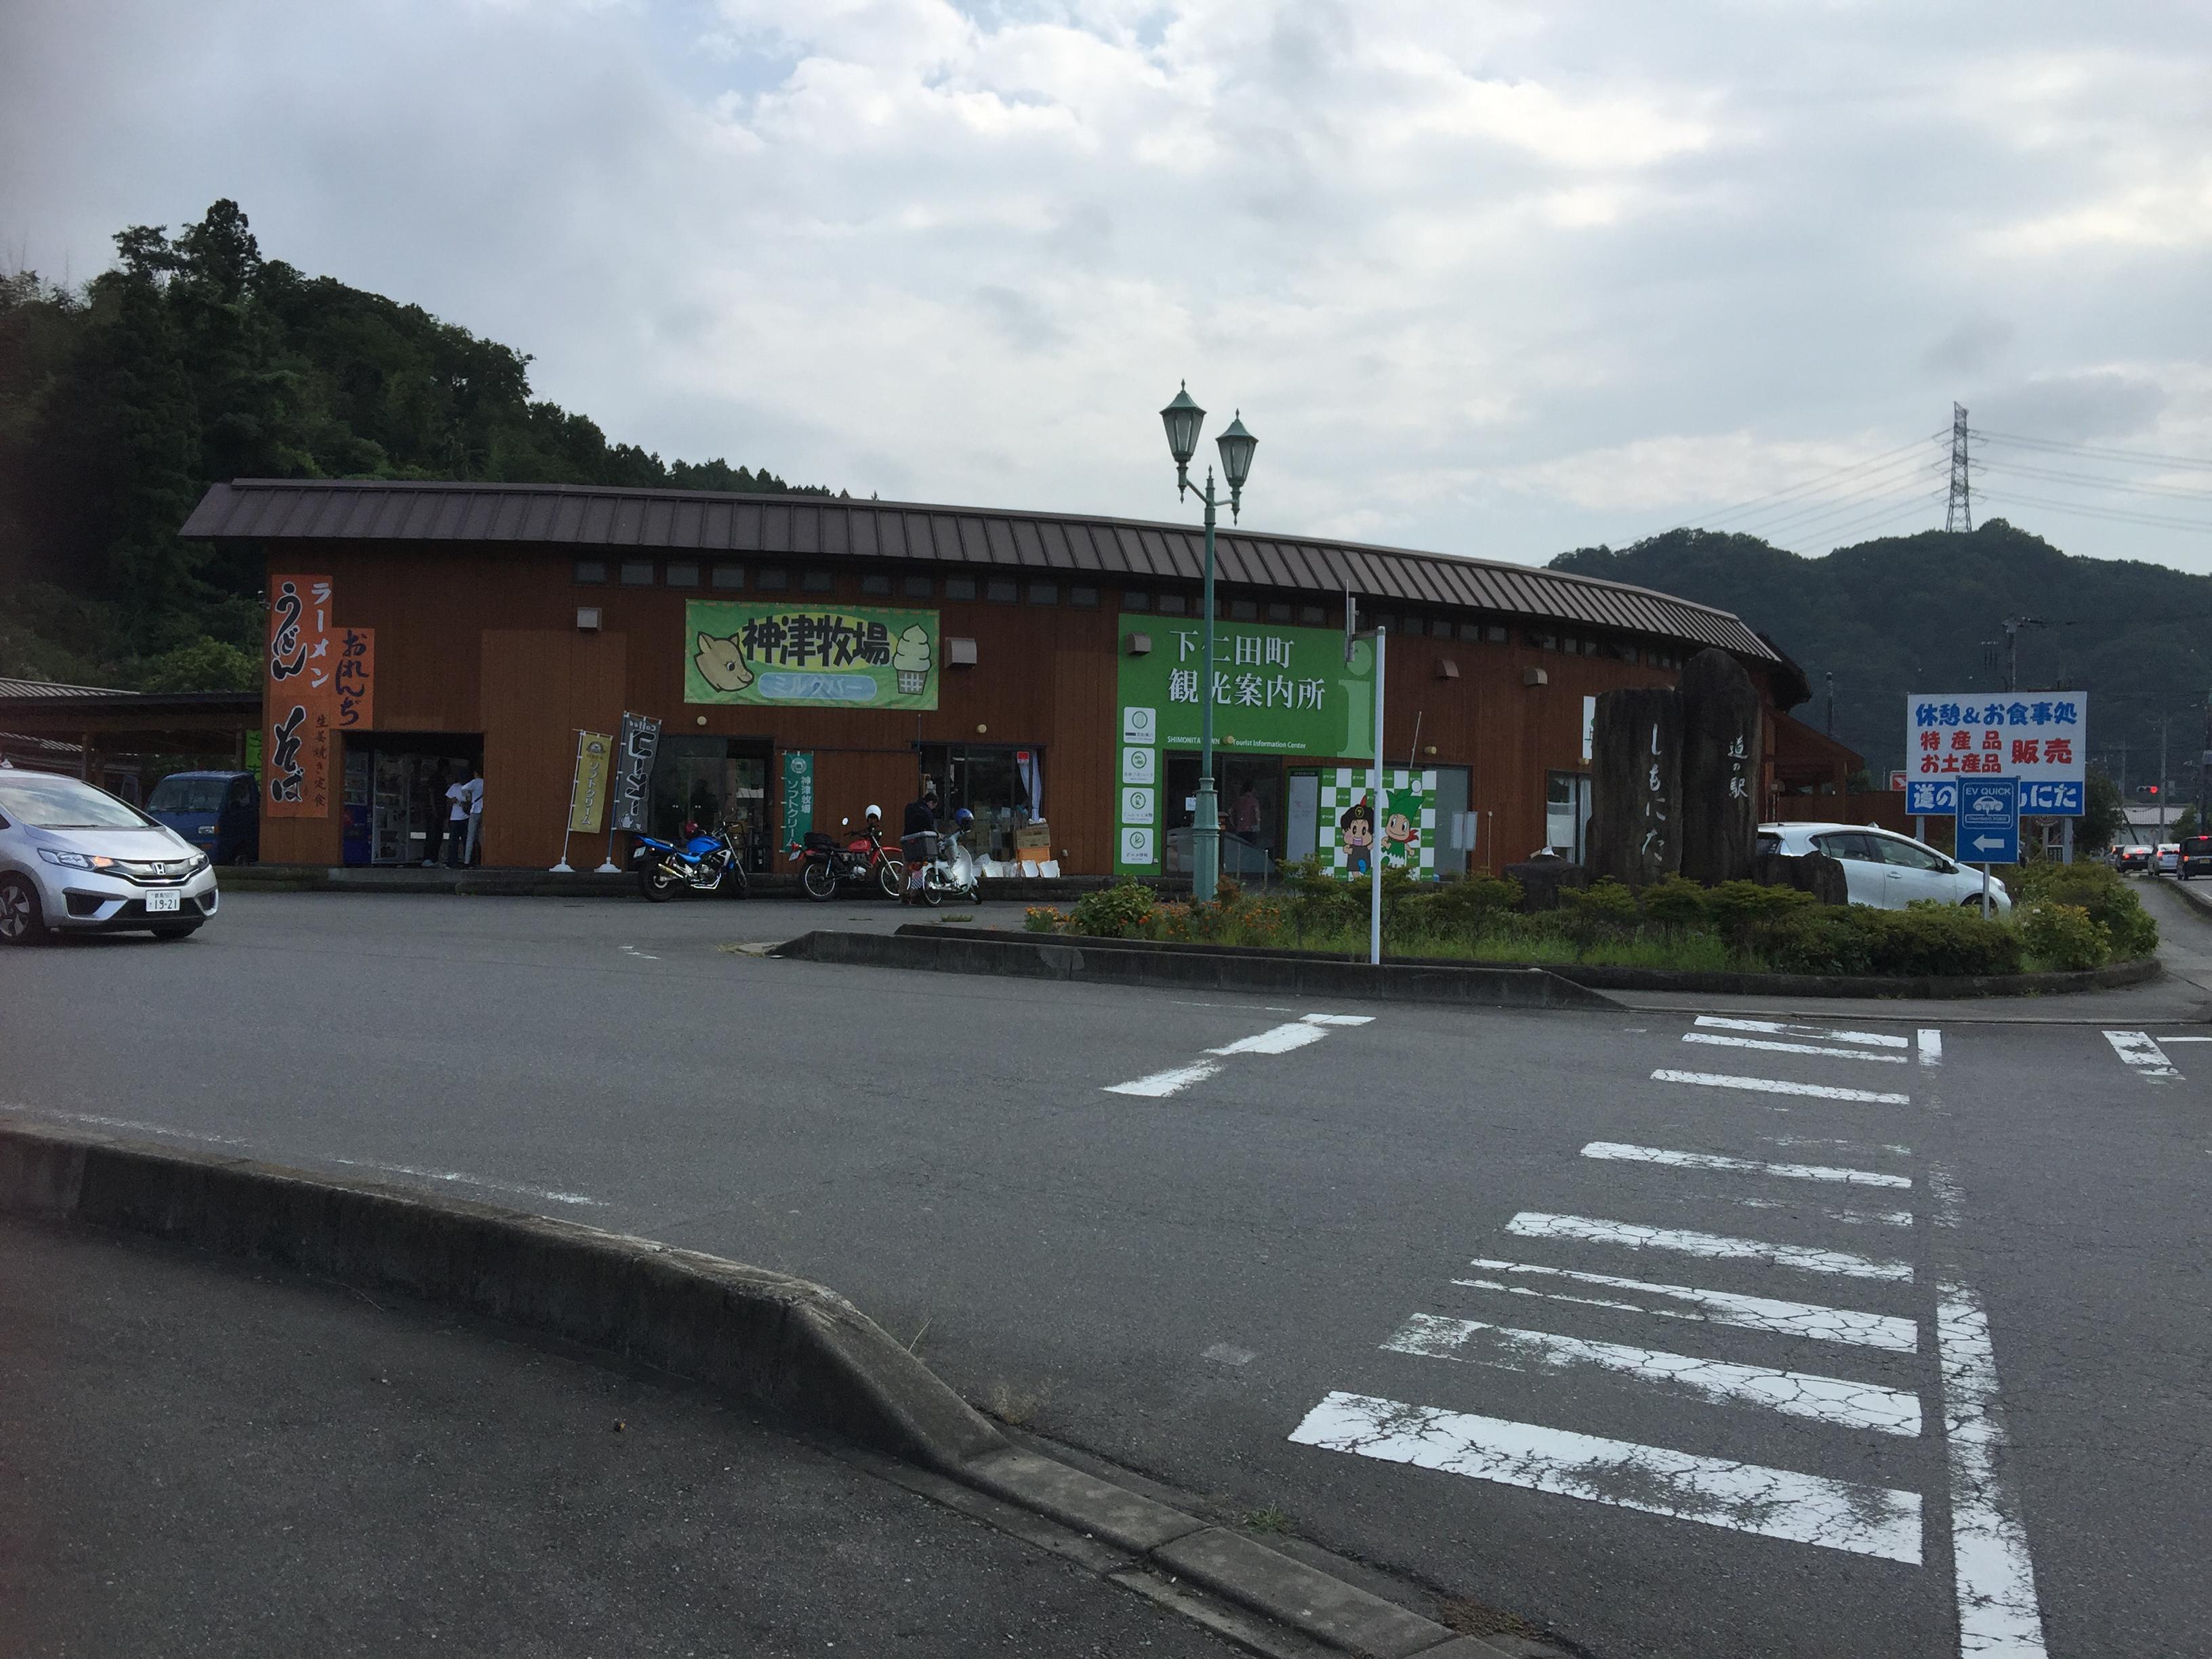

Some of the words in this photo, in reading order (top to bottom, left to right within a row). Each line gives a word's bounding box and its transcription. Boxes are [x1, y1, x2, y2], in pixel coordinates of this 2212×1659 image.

[271, 581, 308, 681] うどん
[310, 582, 331, 688] ラーメン
[742, 615, 890, 666] 神津牧場
[1168, 668, 1326, 710] 観光案内所
[1916, 701, 2077, 726] 休憩&お食事処
[271, 705, 306, 802] そば
[1167, 736, 1201, 744] SHIMONITA
[1253, 739, 1286, 748] Information
[1920, 731, 2002, 751] 特産品
[2011, 738, 2072, 764] 販売
[1727, 735, 1748, 798] 道の駅
[1920, 754, 2002, 773] お土産品
[581, 762, 600, 825] ソフトクリーム
[800, 776, 812, 814] 神津牧場
[1642, 723, 1666, 861] しもにた
[1965, 787, 1979, 796] EV
[1981, 787, 2011, 796] QUICK
